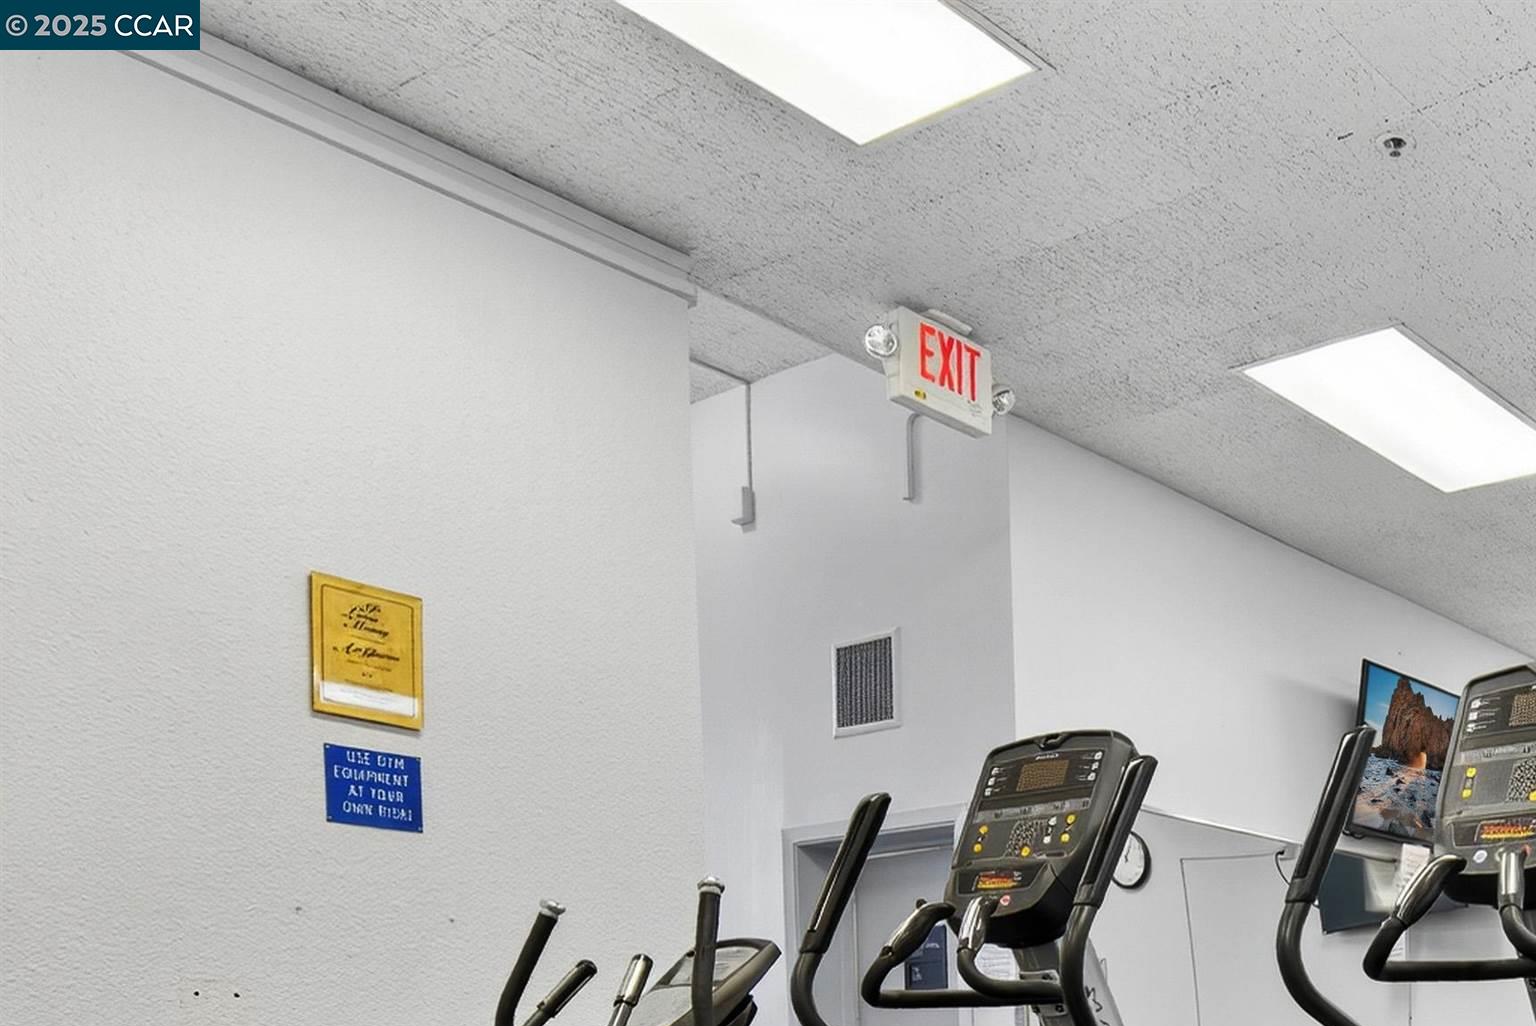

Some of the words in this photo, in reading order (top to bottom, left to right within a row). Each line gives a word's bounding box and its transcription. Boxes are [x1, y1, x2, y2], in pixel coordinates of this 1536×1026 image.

[919, 321, 981, 402] EXIT
[346, 750, 370, 766] USE
[333, 764, 409, 787] EQUIPMENT
[348, 784, 364, 798] AT
[369, 786, 404, 803] YOUR
[342, 800, 373, 816] OWN
